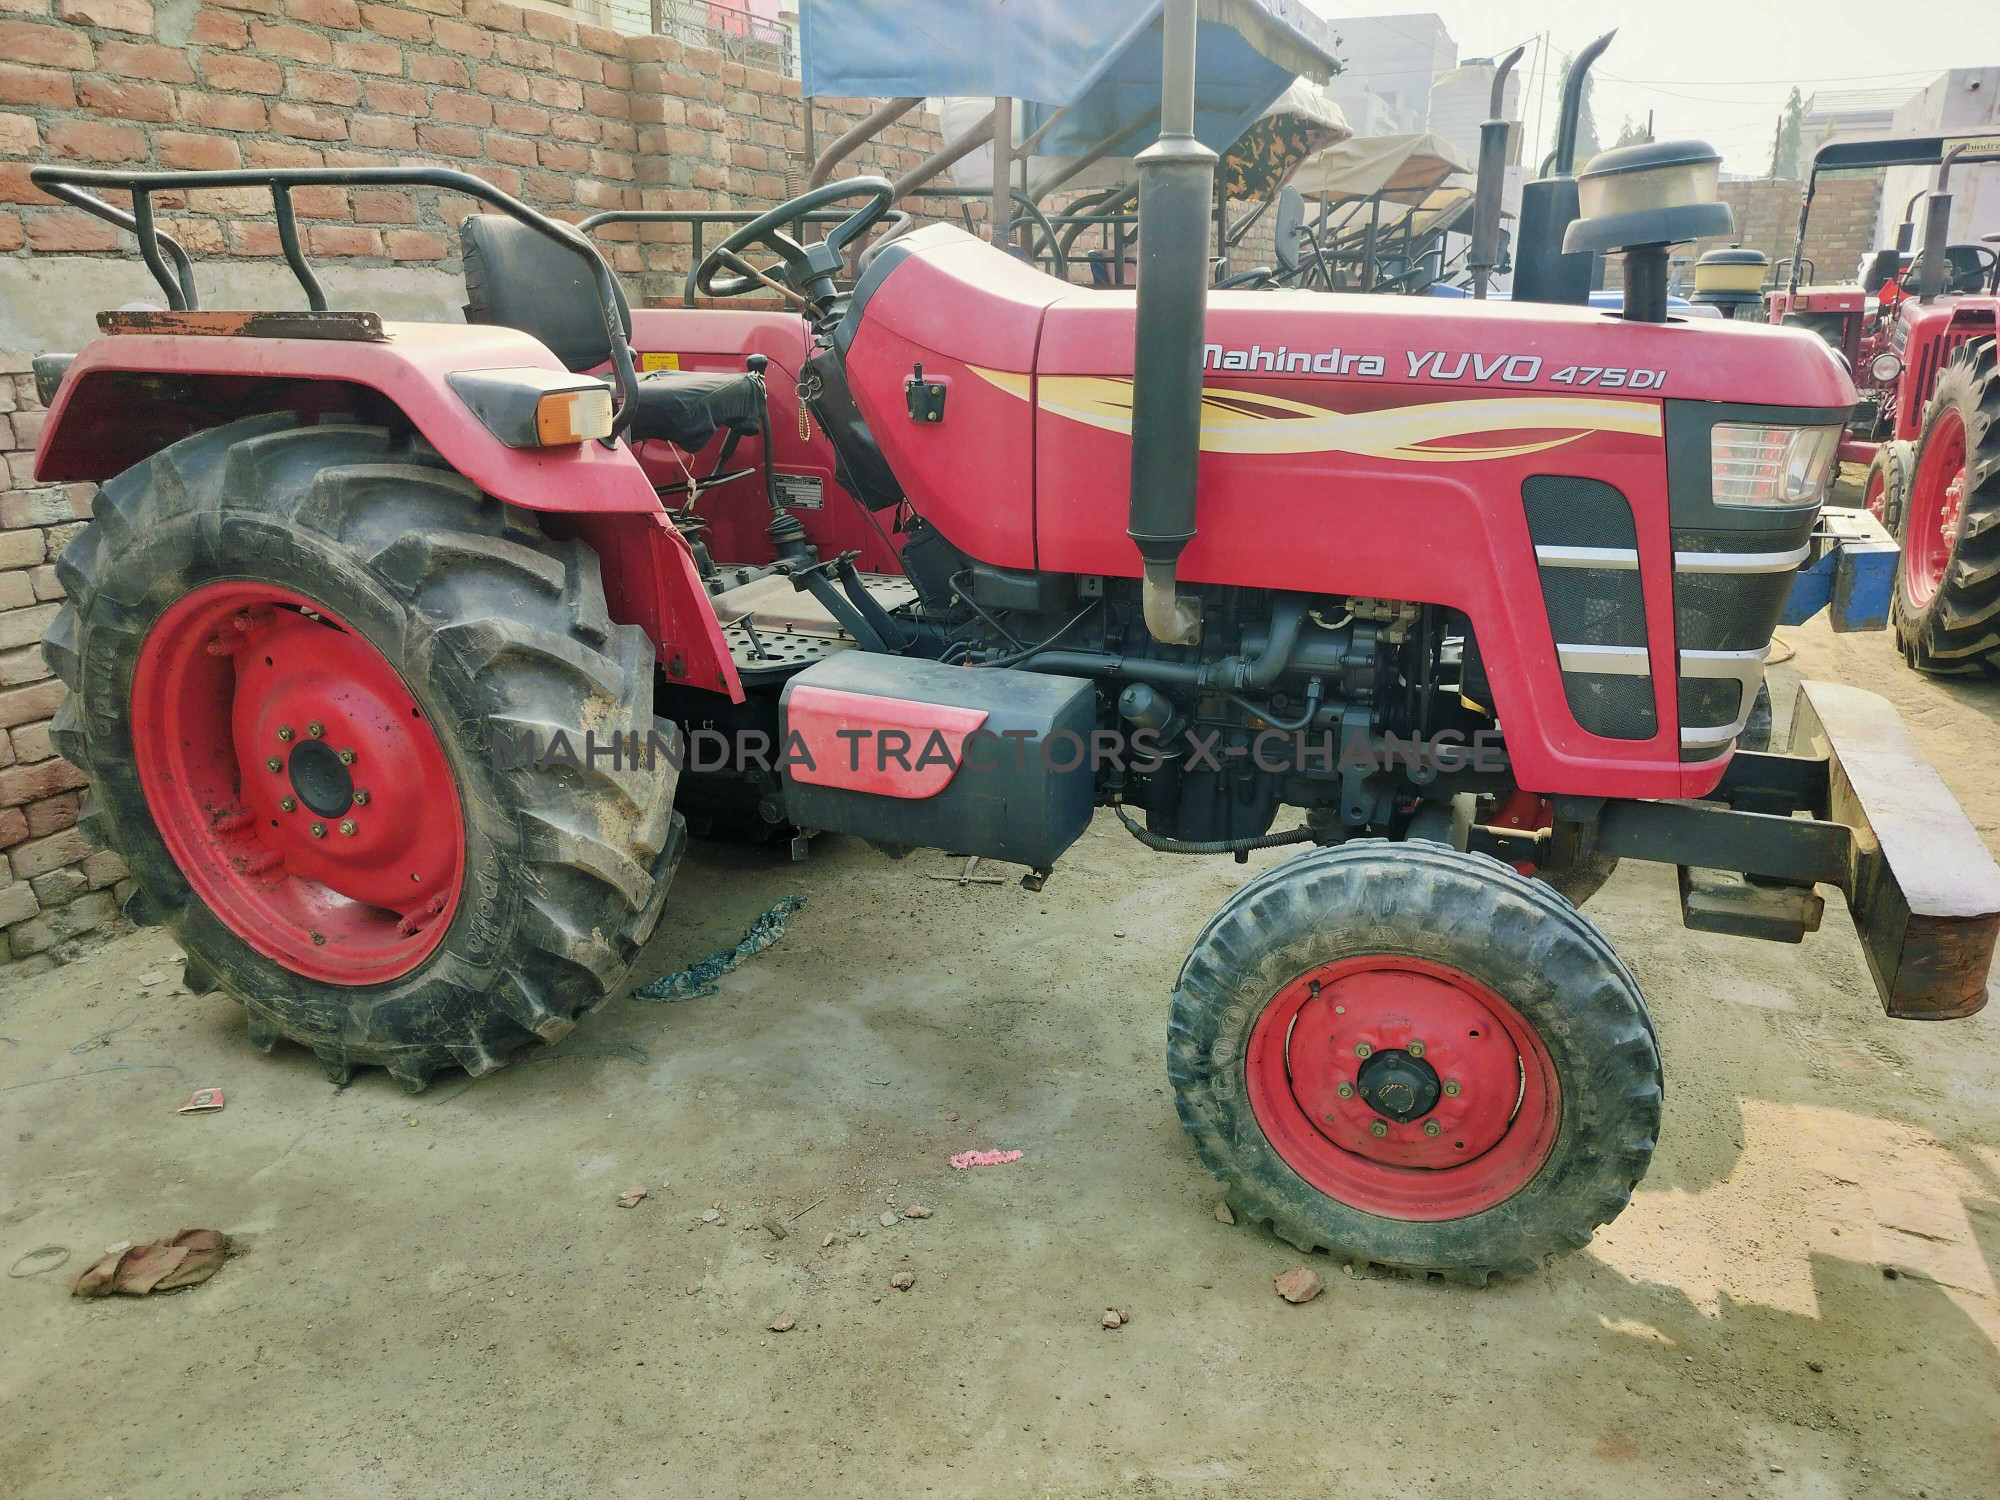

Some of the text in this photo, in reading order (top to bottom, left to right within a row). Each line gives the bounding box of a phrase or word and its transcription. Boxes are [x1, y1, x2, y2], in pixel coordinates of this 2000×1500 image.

[1406, 350, 1543, 383] YUVO
[1550, 366, 1668, 389] 475DI
[465, 853, 501, 953] apollo
